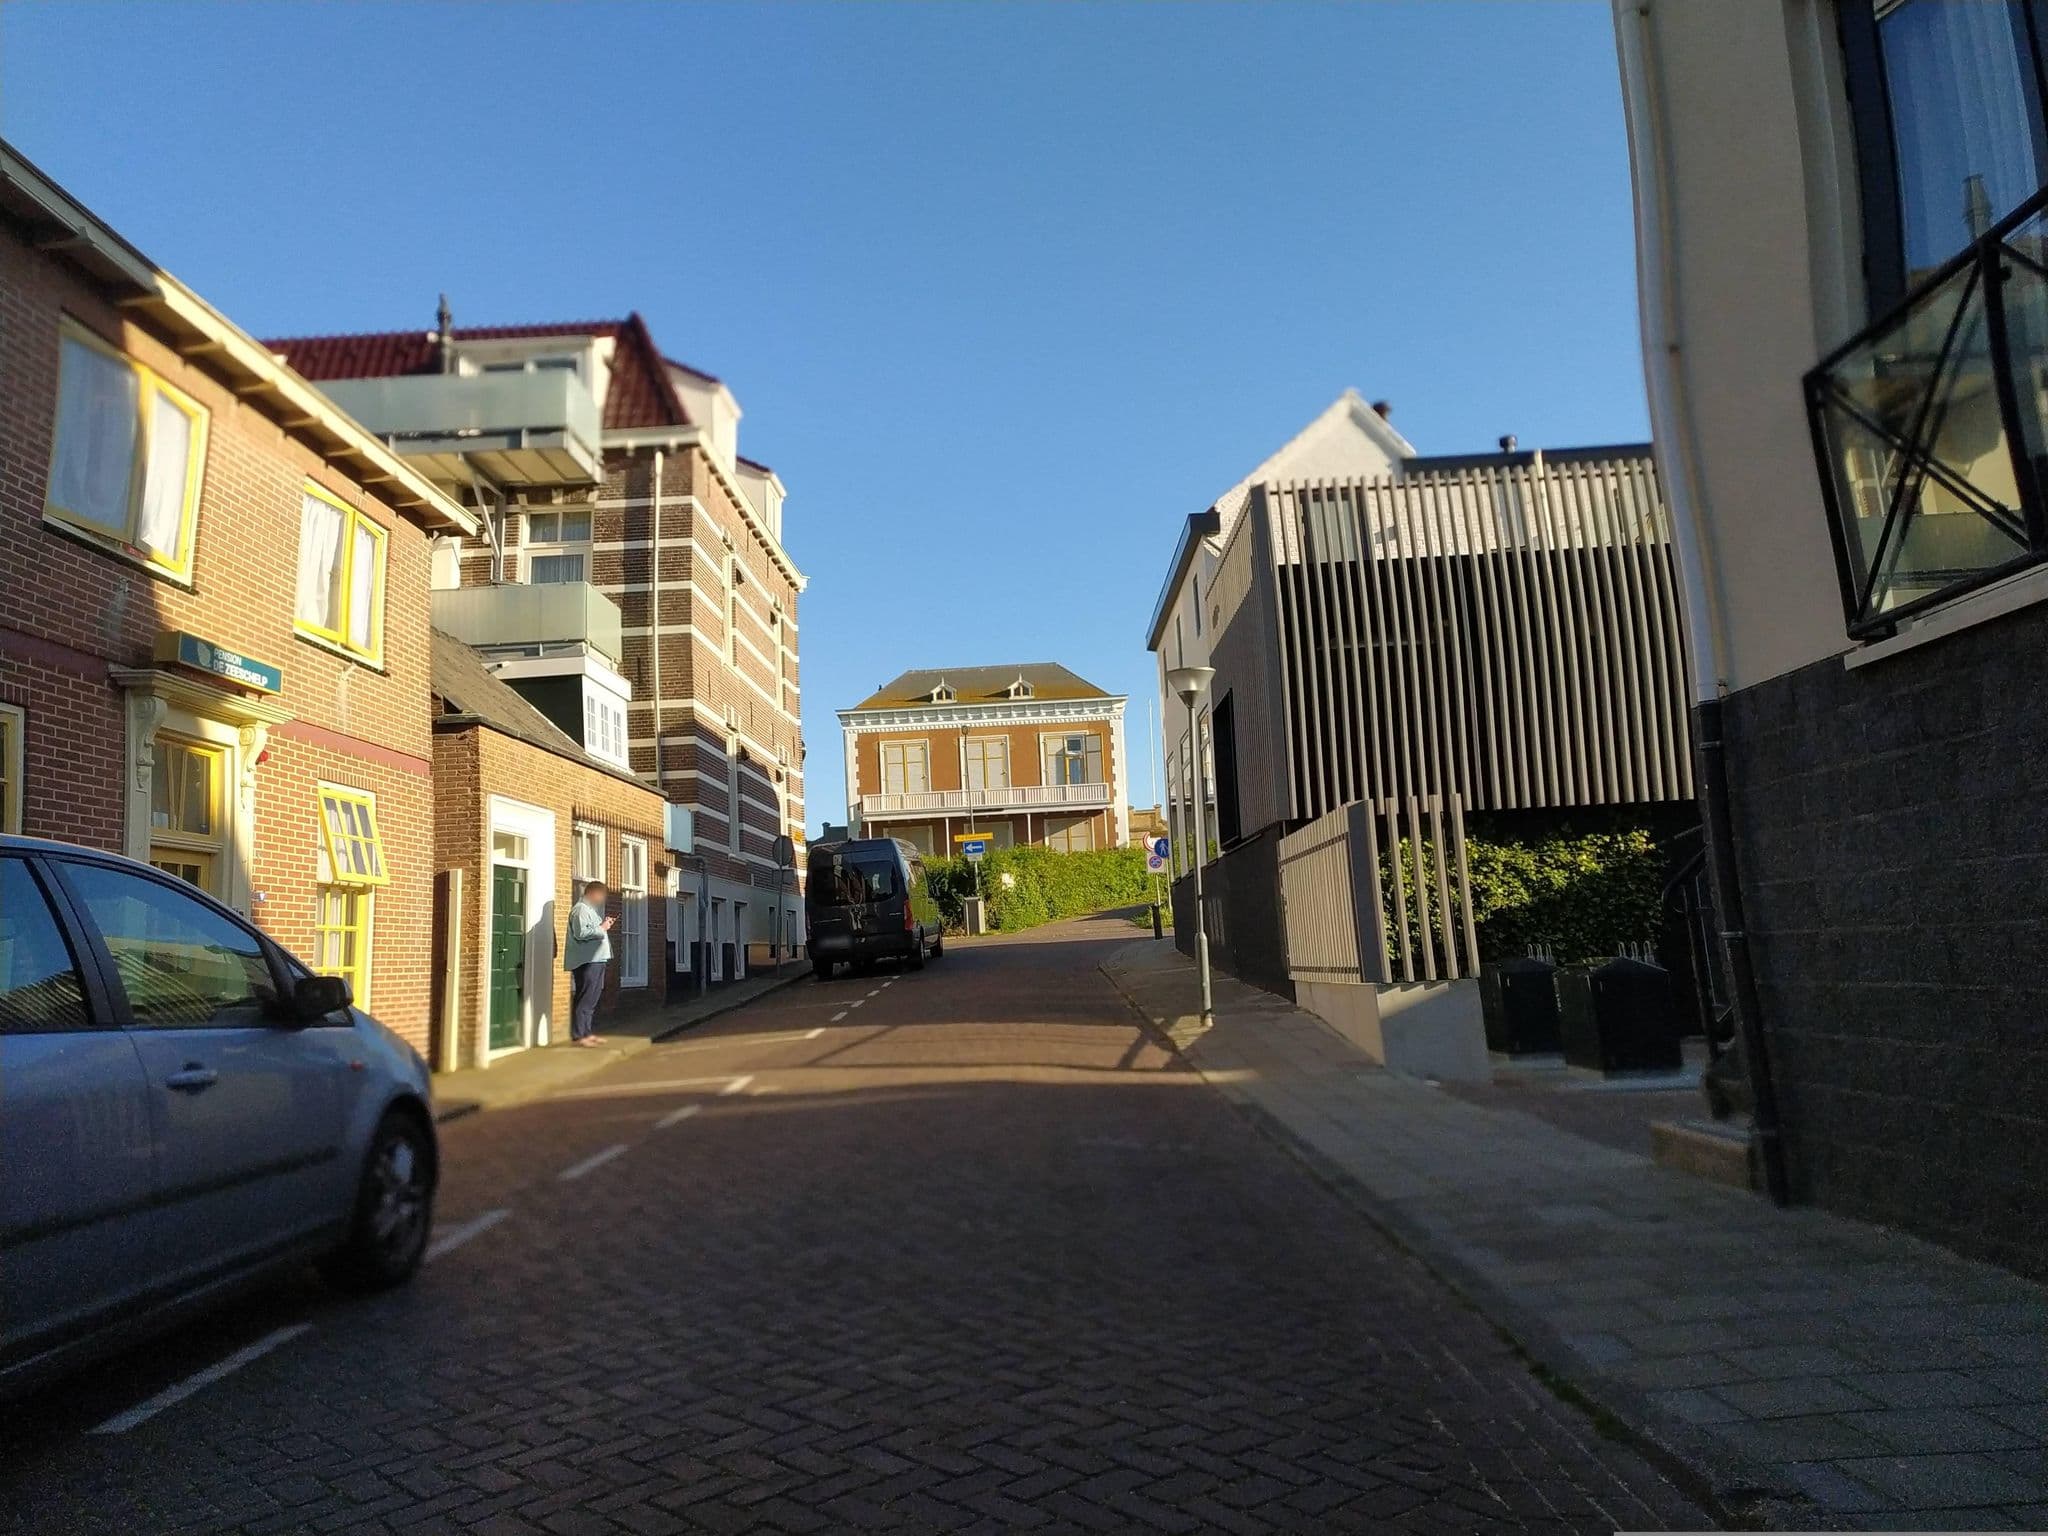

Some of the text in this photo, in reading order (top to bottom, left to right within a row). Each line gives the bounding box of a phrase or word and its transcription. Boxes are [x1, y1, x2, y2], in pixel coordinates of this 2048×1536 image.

[213, 648, 242, 666] PENSION
[213, 660, 268, 687] DE ZEESCHELP
